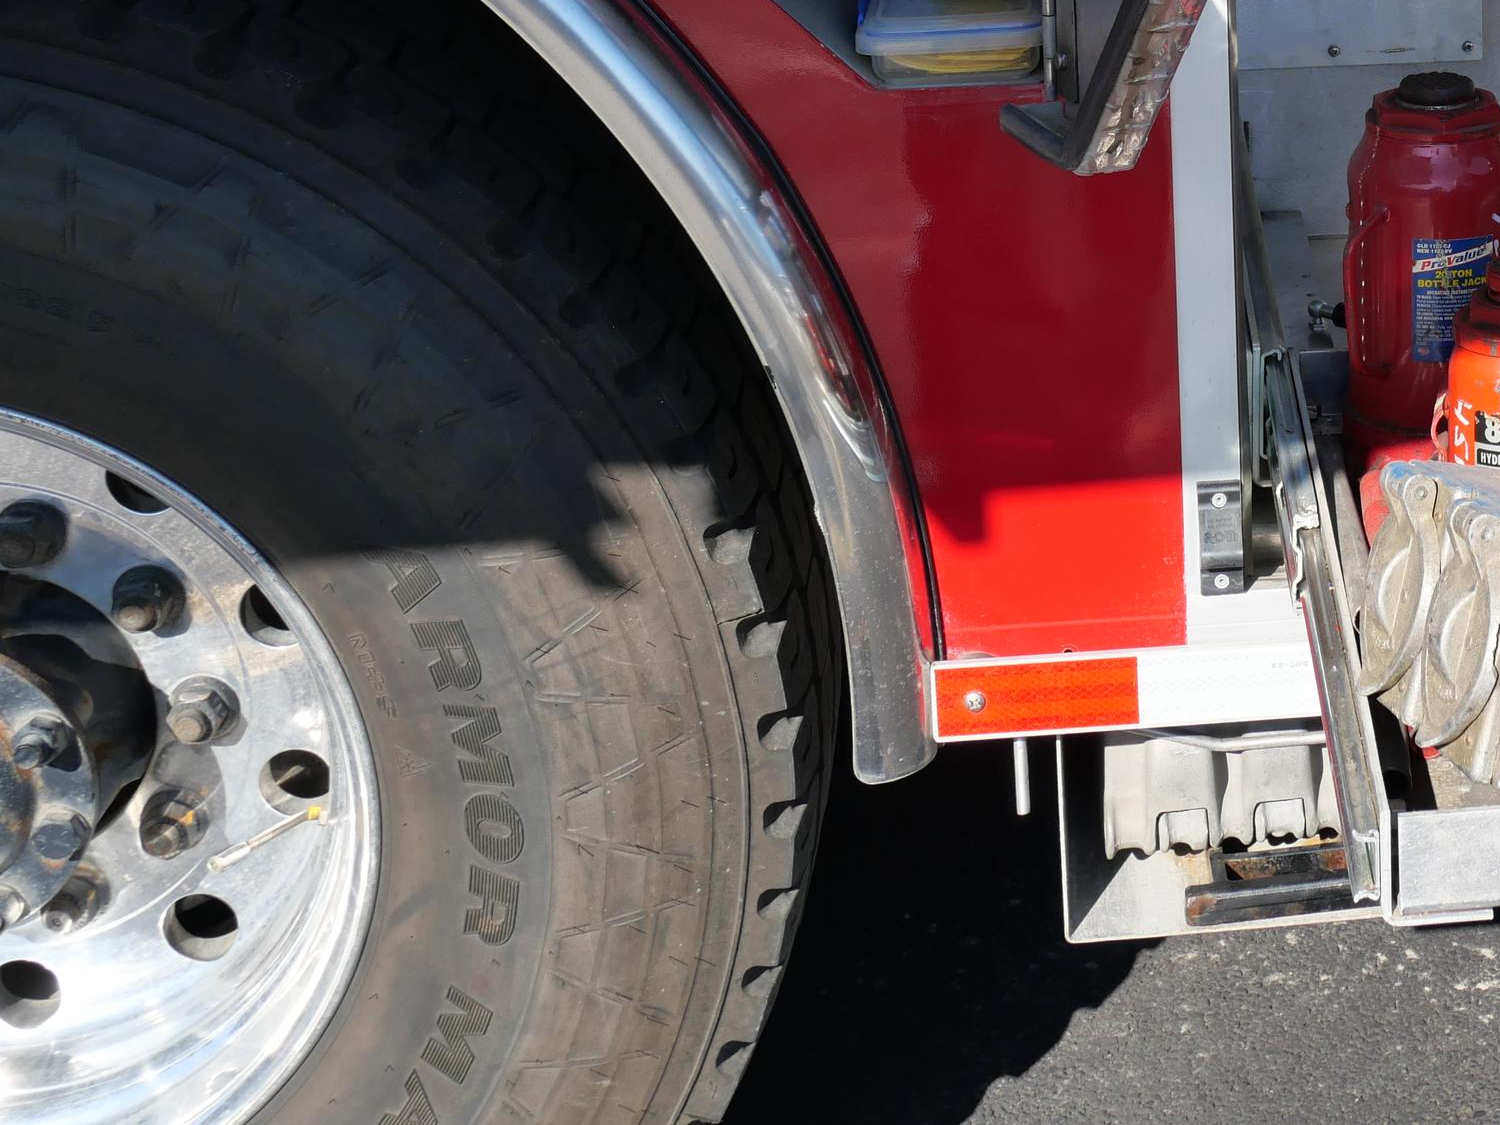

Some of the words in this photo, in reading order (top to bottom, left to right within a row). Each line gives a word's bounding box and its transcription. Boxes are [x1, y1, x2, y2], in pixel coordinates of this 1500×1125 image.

[1452, 269, 1473, 278] TON
[1417, 278, 1460, 288] BOTTLE
[1462, 276, 1488, 287] JACK
[361, 545, 525, 946] ARMOR
